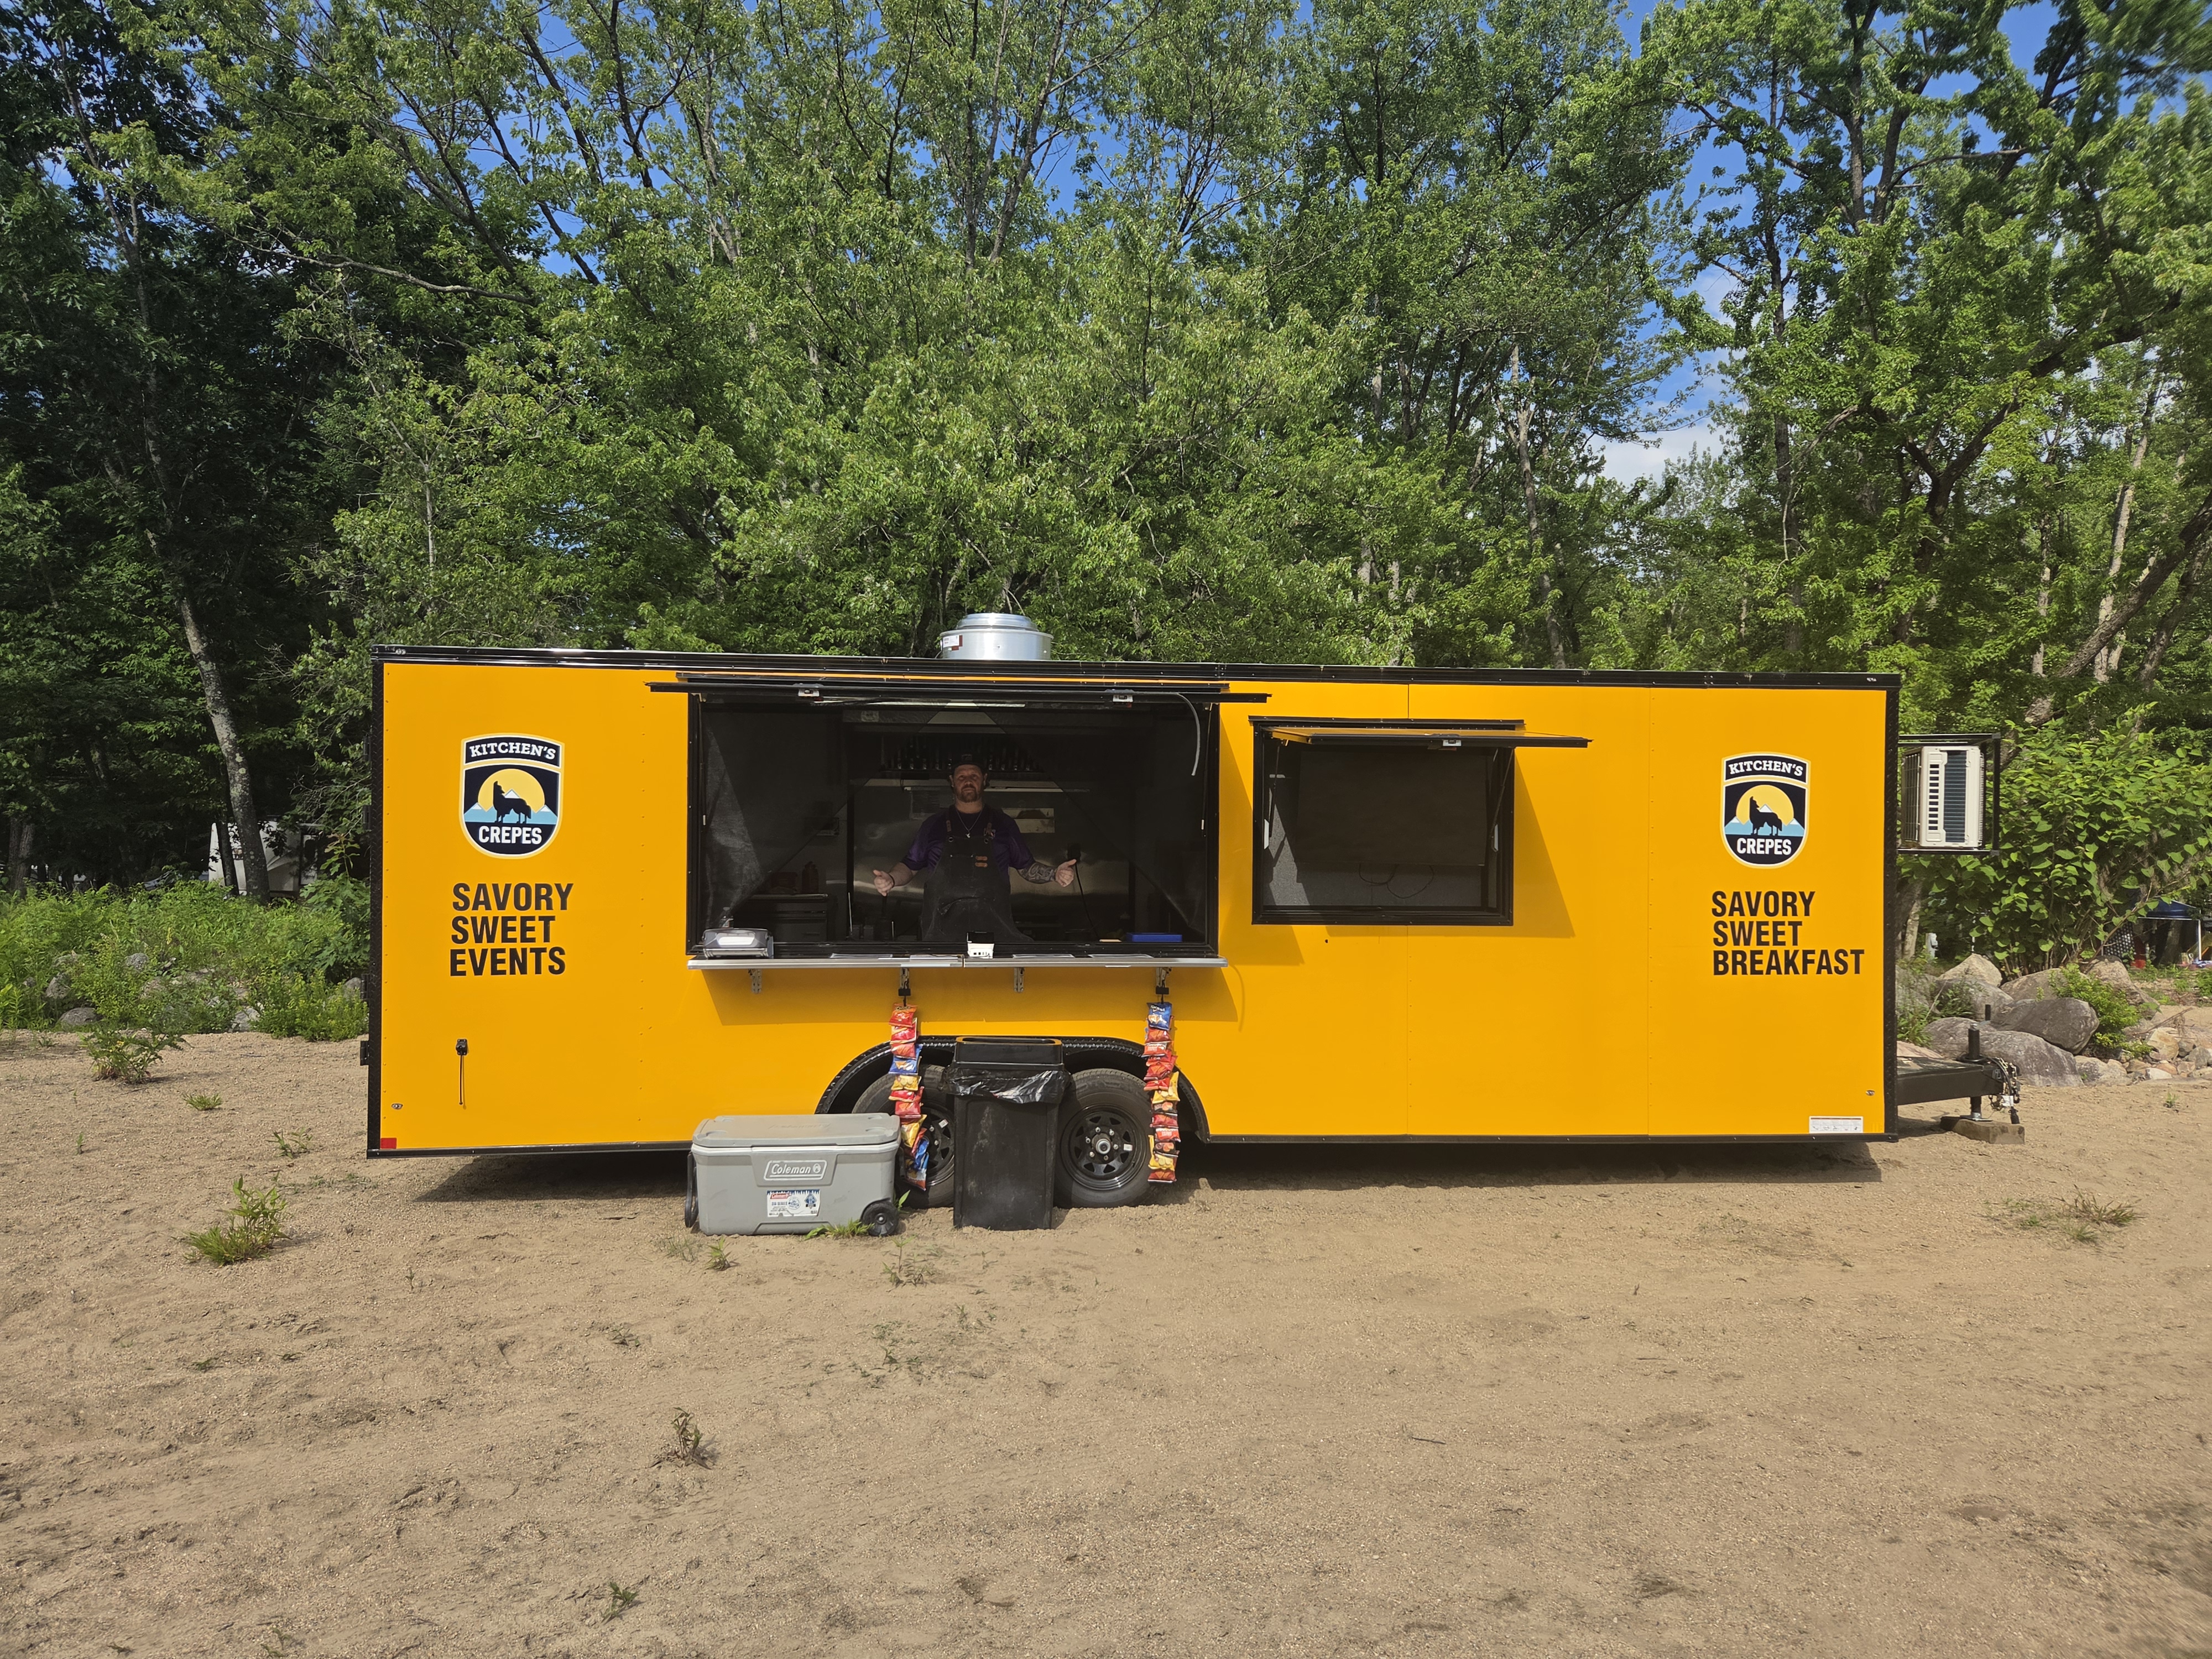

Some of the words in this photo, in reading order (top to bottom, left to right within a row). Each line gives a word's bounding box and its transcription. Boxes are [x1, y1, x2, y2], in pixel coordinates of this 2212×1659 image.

[469, 742, 556, 760] KITCHEN'S
[1728, 759, 1803, 777] KITCHEN'S
[478, 826, 542, 845] CREPES
[1736, 837, 1792, 855] CREPES
[452, 883, 573, 911] SAVORY
[1712, 890, 1815, 917] SAVORY
[451, 915, 556, 945] SWEET
[1713, 920, 1803, 947] SWEET
[450, 946, 566, 977] EVENTS
[1713, 948, 1865, 975] BREAKFAST
[771, 1164, 811, 1175] Coleman
